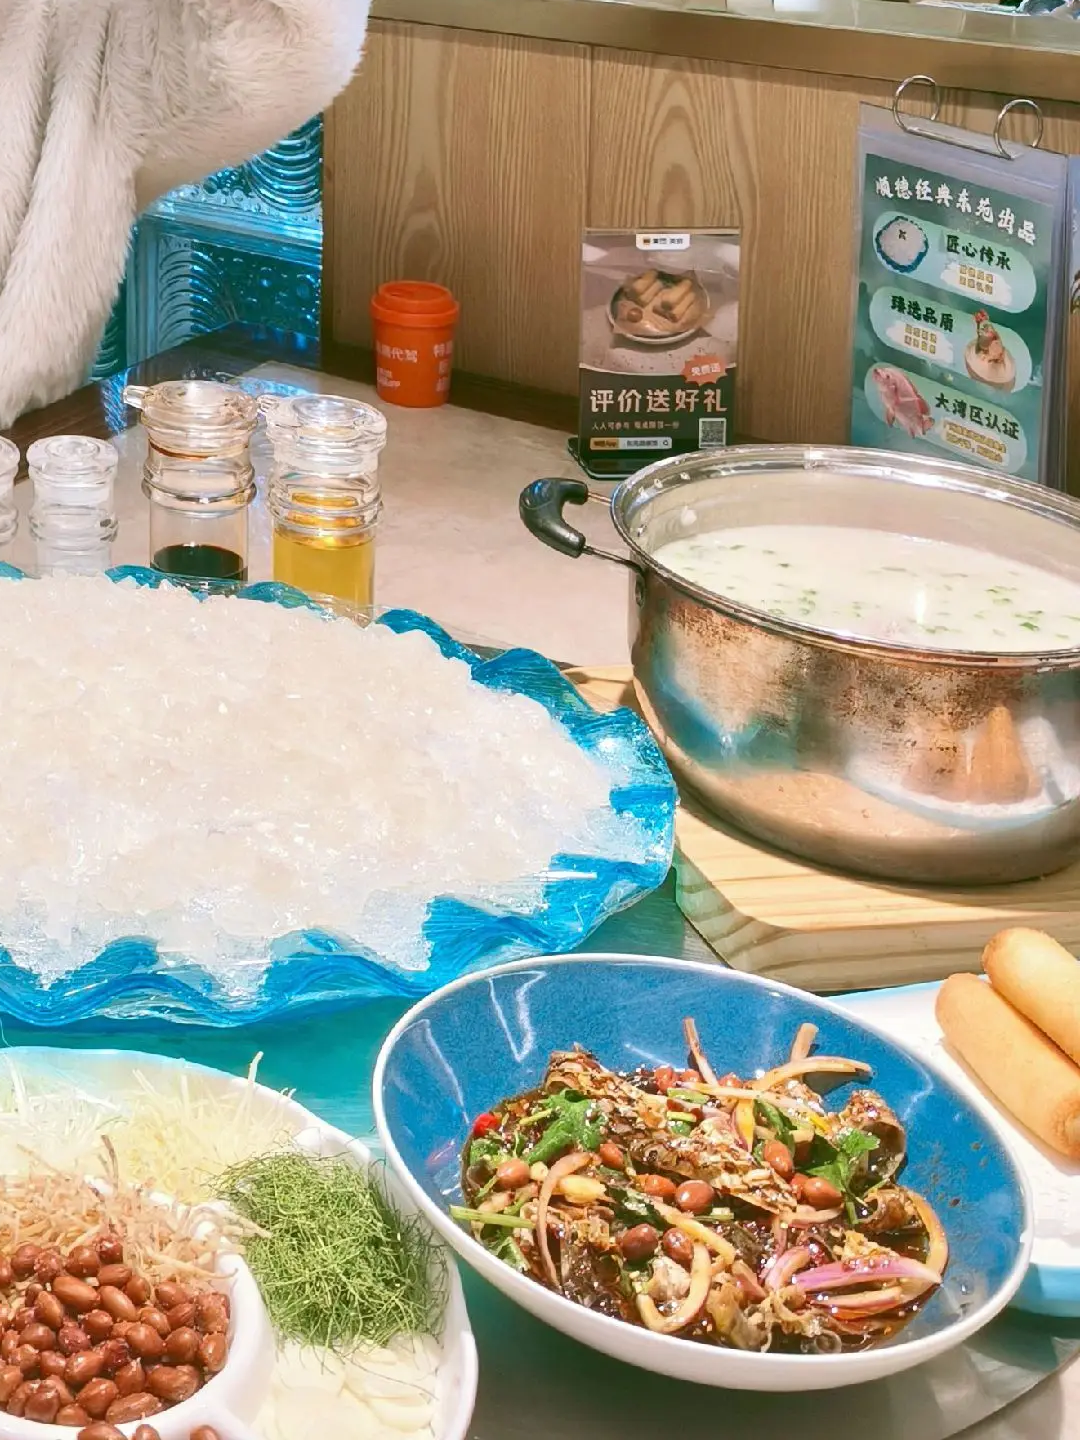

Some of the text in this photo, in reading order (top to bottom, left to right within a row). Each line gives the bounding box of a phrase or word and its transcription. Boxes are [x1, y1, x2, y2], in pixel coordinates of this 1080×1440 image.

[946, 234, 1012, 271] 匠心传承
[891, 295, 954, 333] 臻选品质
[590, 389, 728, 413] 评价送好礼
[935, 392, 1020, 440] 大湾区认证
